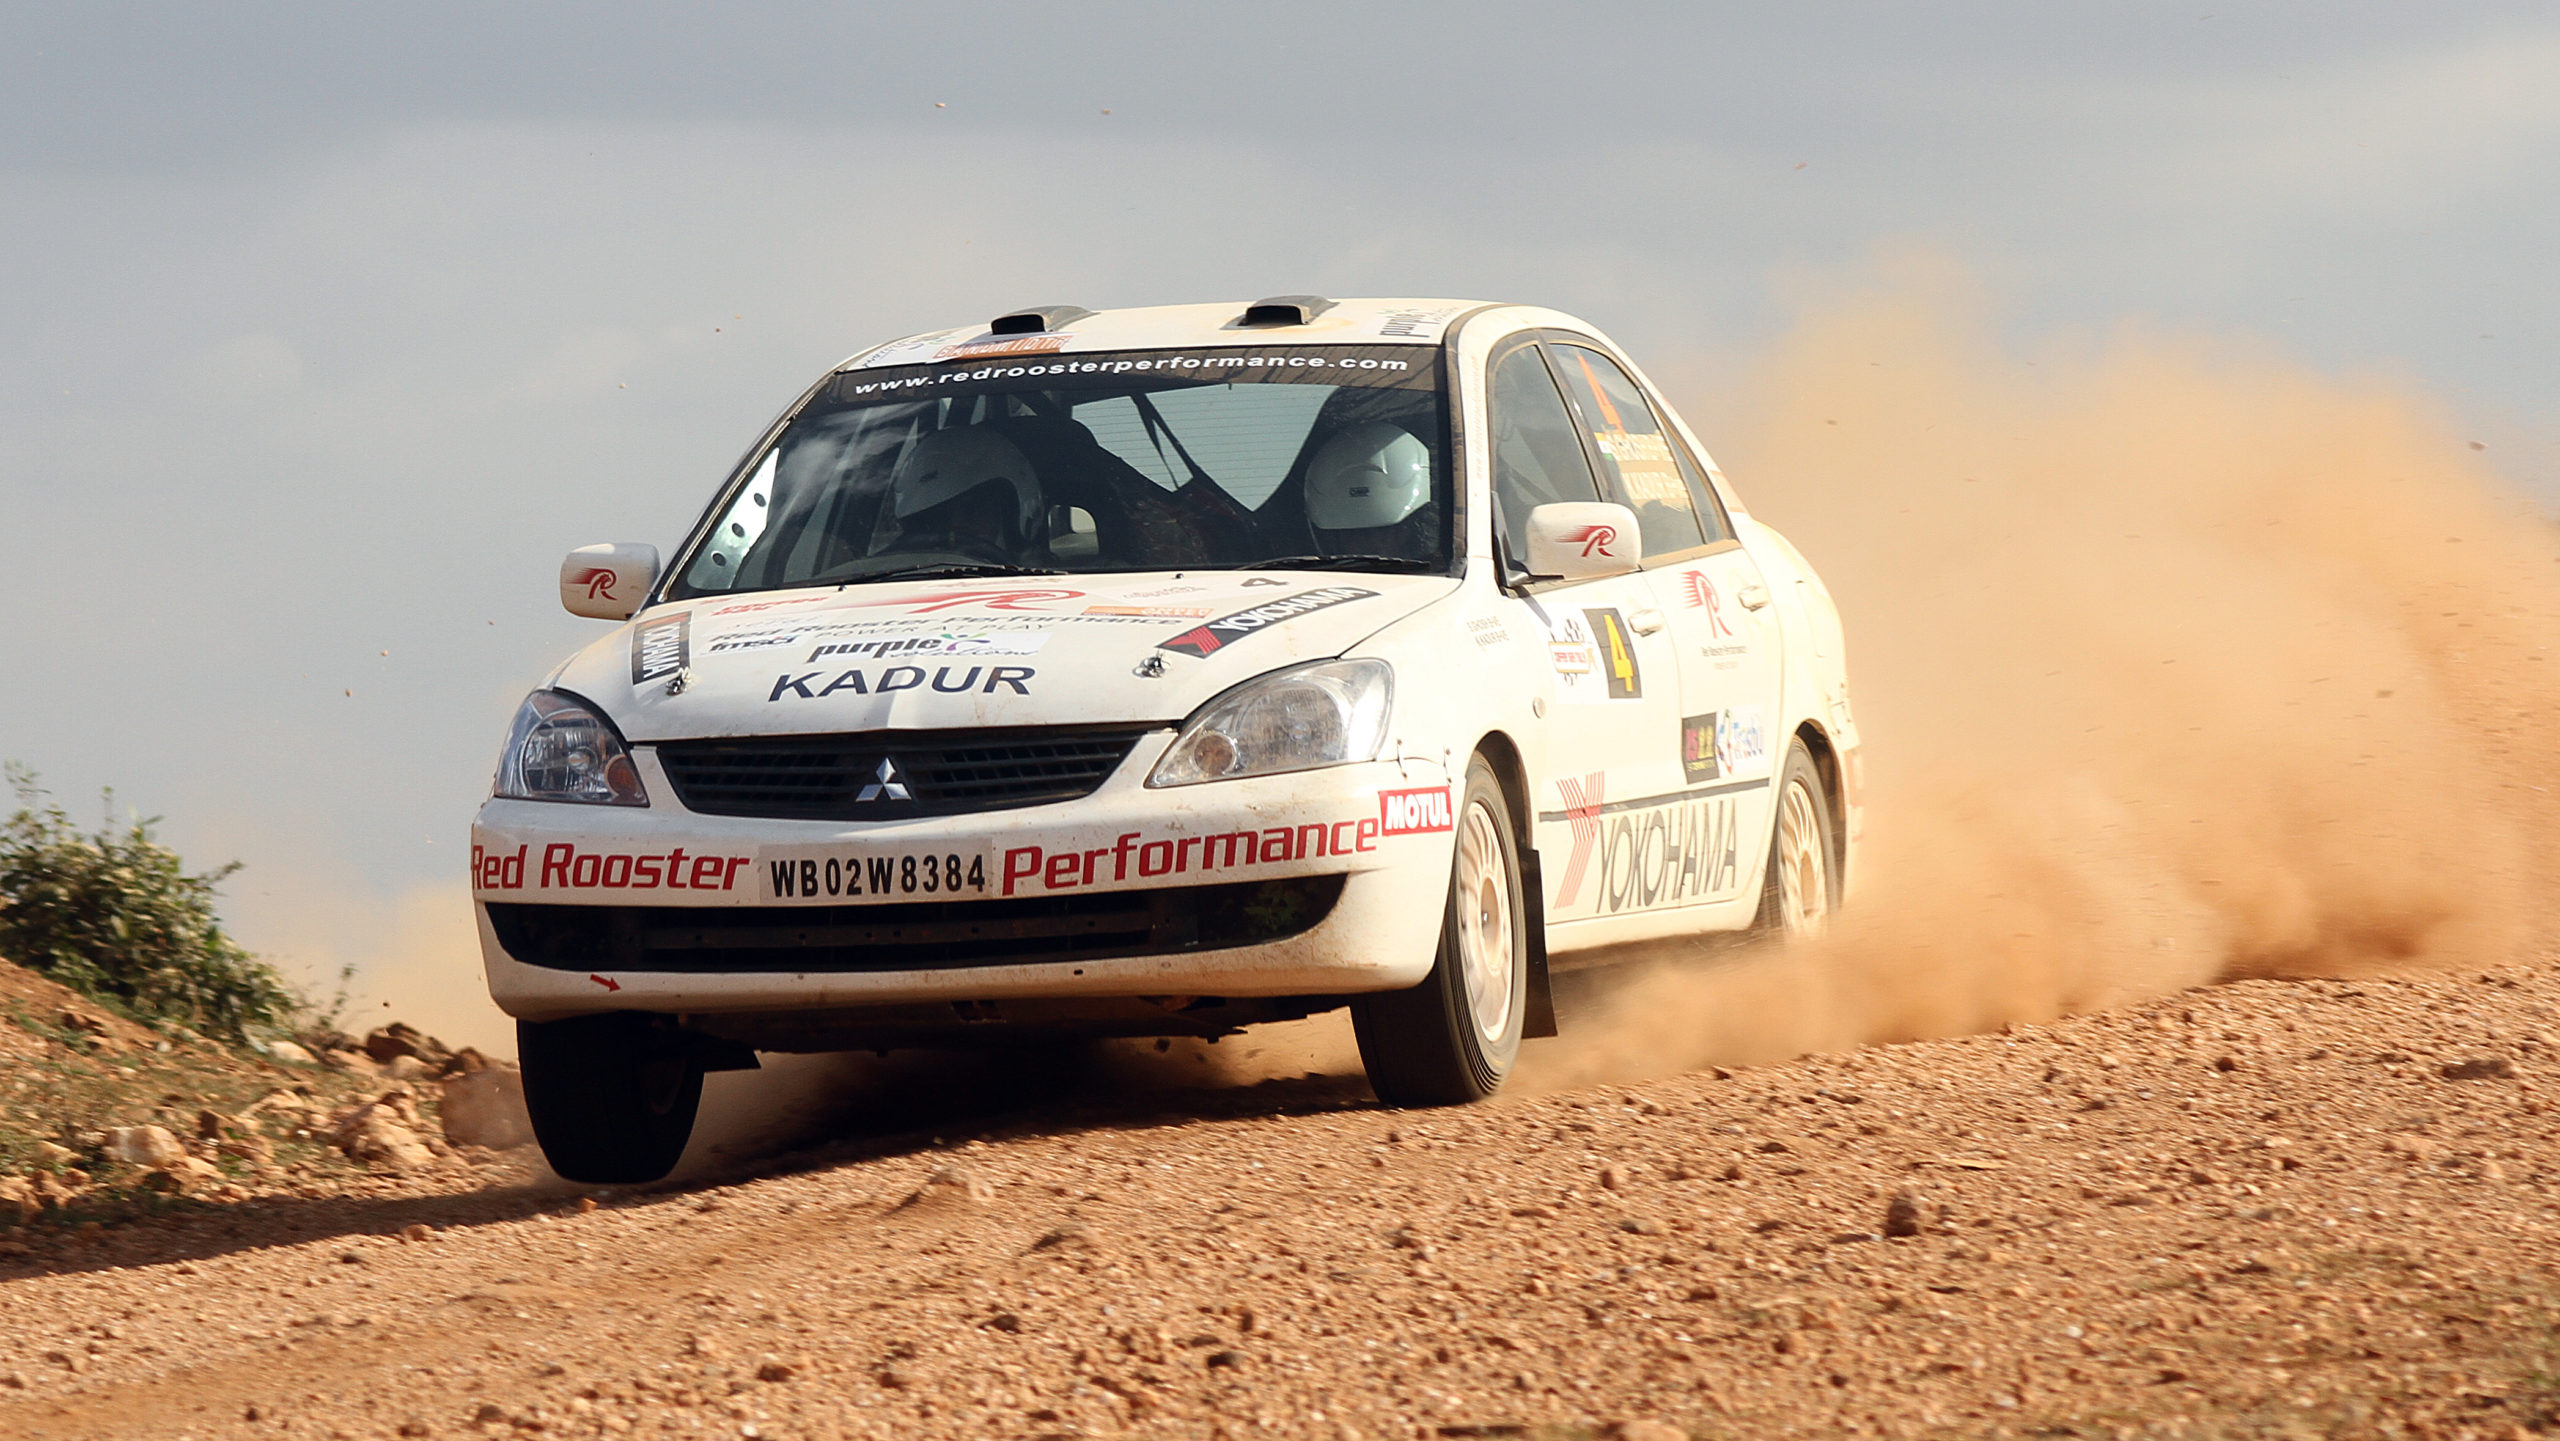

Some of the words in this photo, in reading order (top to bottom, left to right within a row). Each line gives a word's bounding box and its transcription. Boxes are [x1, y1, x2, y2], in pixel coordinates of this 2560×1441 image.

[854, 355, 1408, 395] www.redroosterperformance.com
[791, 618, 938, 633] Rooster
[942, 614, 1185, 626] Performance
[1209, 587, 1369, 631] YOKOHAMA
[805, 637, 943, 664] purple
[815, 625, 921, 638] POWER
[1603, 614, 1634, 692] 4
[768, 666, 1036, 702] KADUR
[1385, 792, 1450, 831] MOTUL
[471, 843, 528, 891] Red
[541, 842, 750, 891] Rooster
[771, 854, 986, 898] WB02W8384
[1002, 816, 1378, 896] Performance
[1597, 798, 1737, 913] YOKOHAMA
